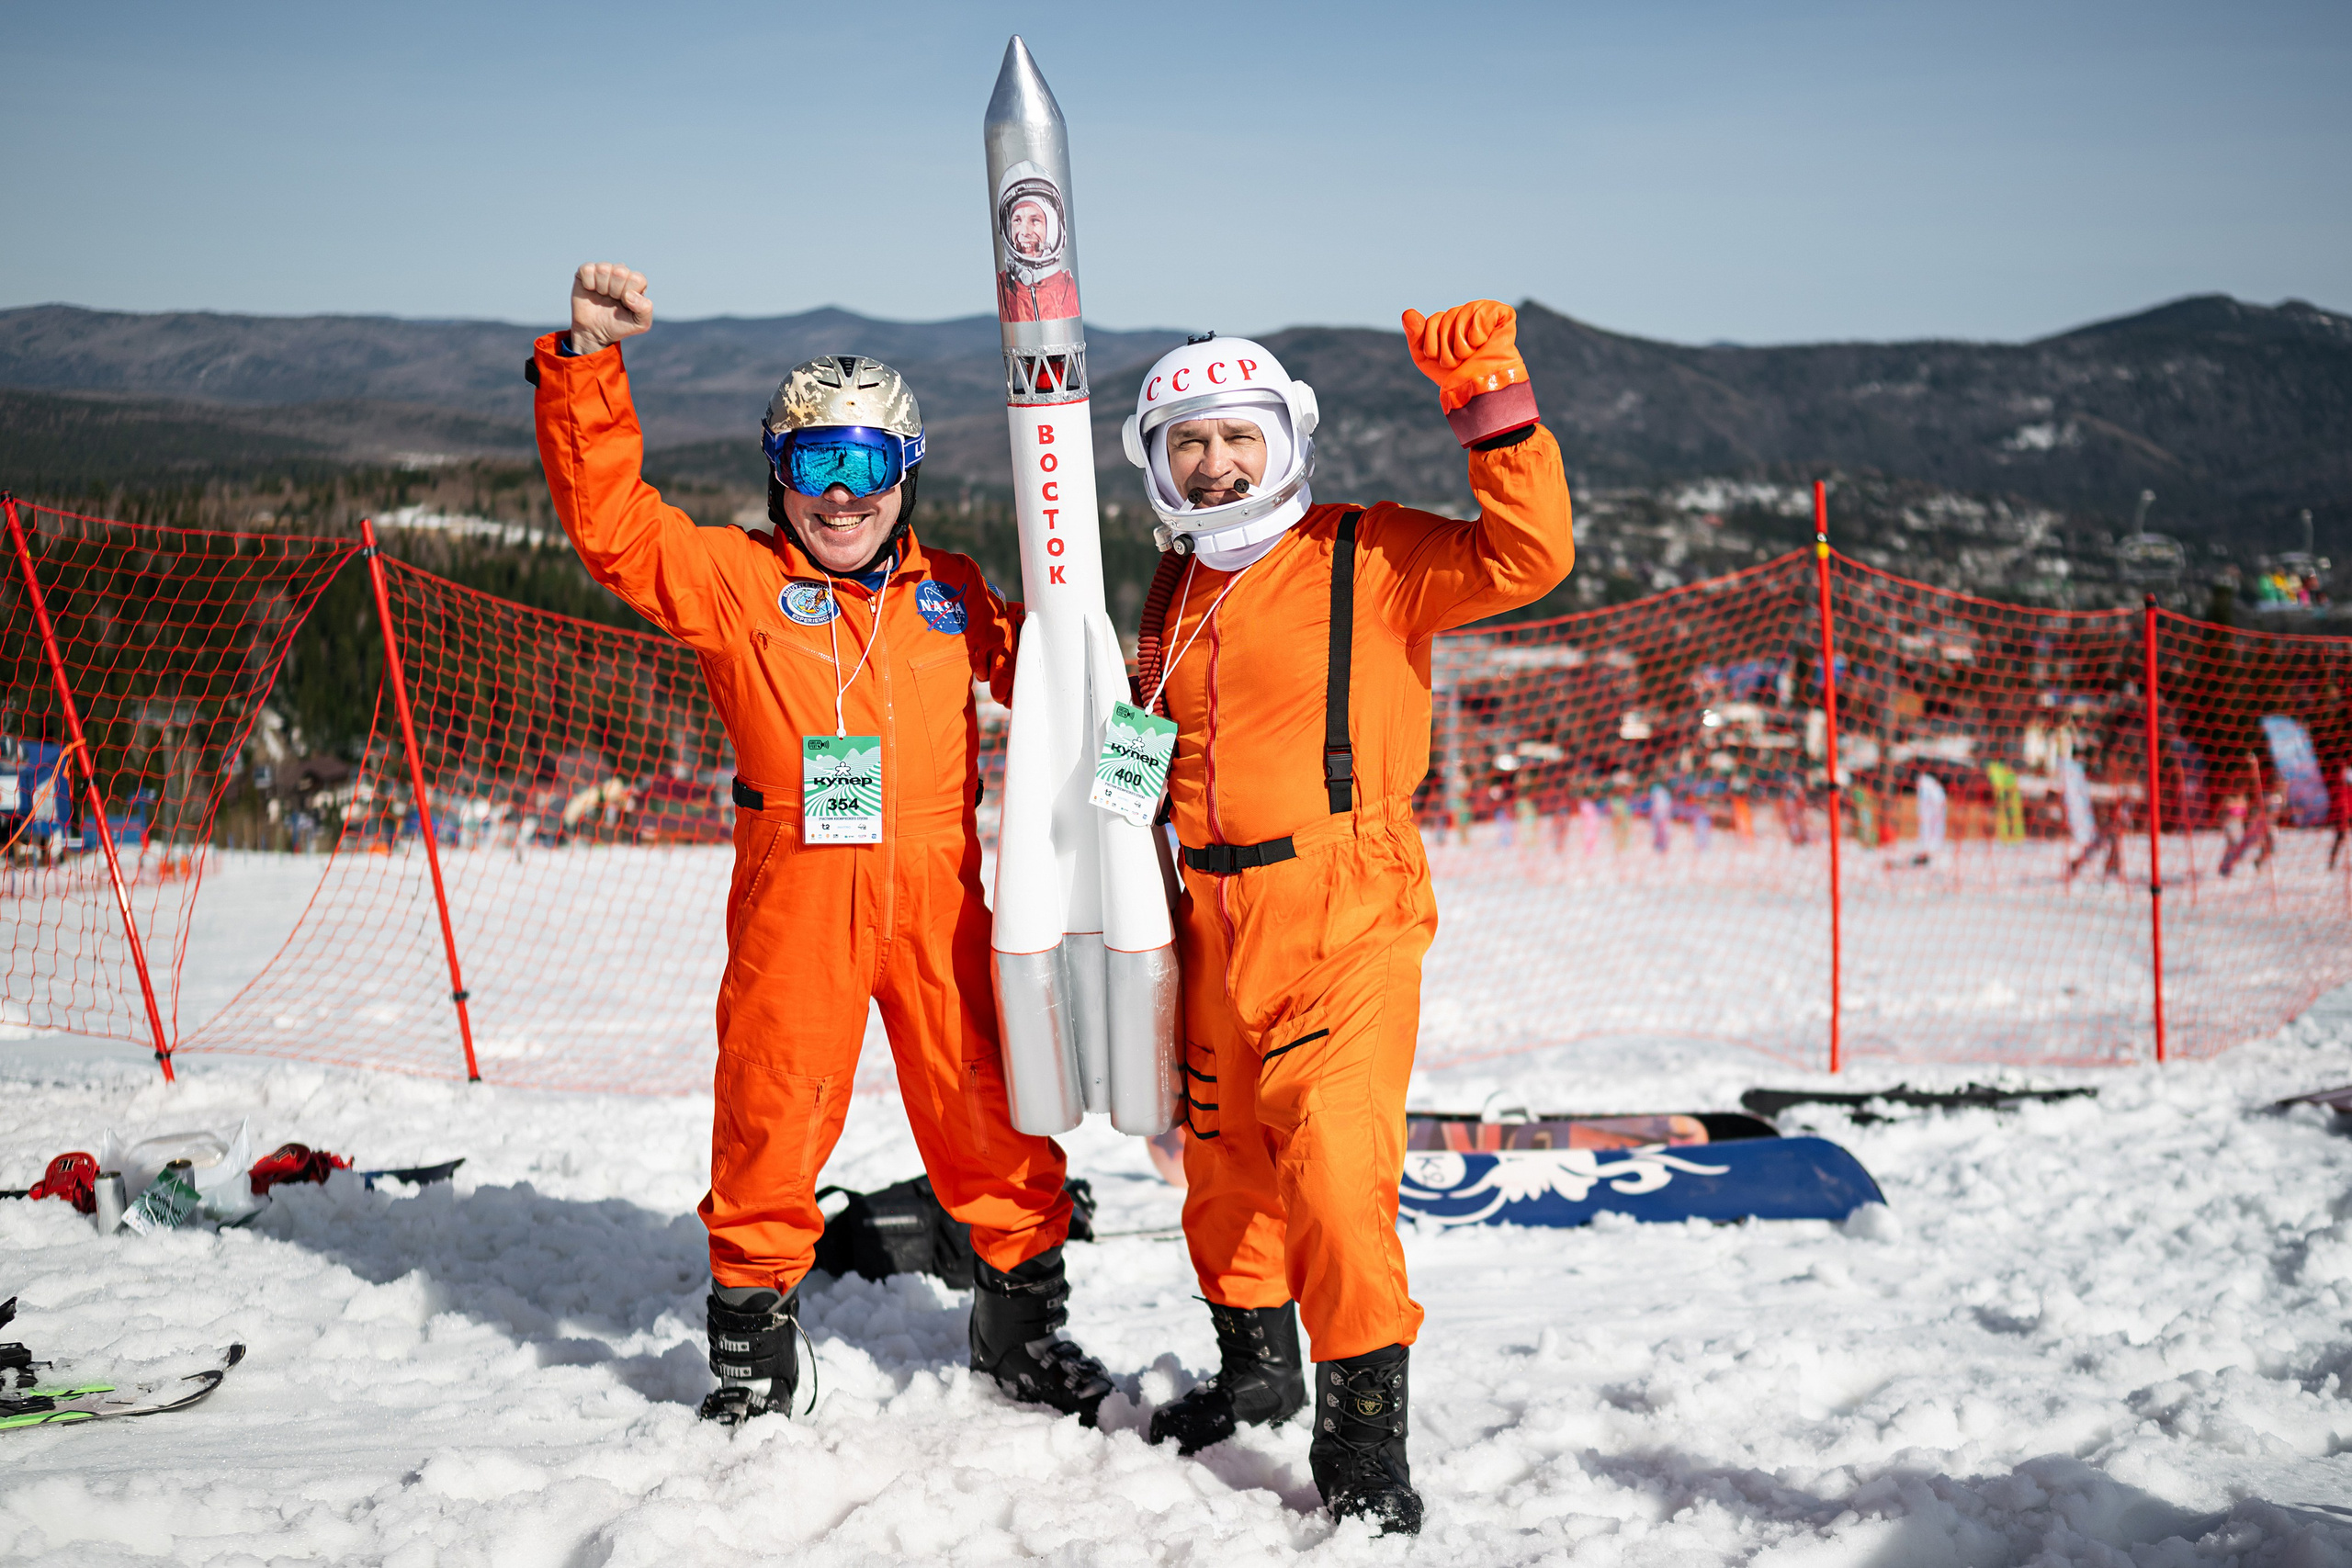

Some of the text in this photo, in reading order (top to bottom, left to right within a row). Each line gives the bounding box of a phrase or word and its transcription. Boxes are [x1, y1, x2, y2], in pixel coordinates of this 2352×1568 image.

[1146, 359, 1257, 401] СССР
[1037, 424, 1067, 584] ВОСТОК
[919, 599, 965, 615] NASA
[1111, 743, 1159, 767] купер
[814, 777, 873, 787] купер
[1115, 768, 1142, 786] 400
[827, 798, 860, 810] 354
